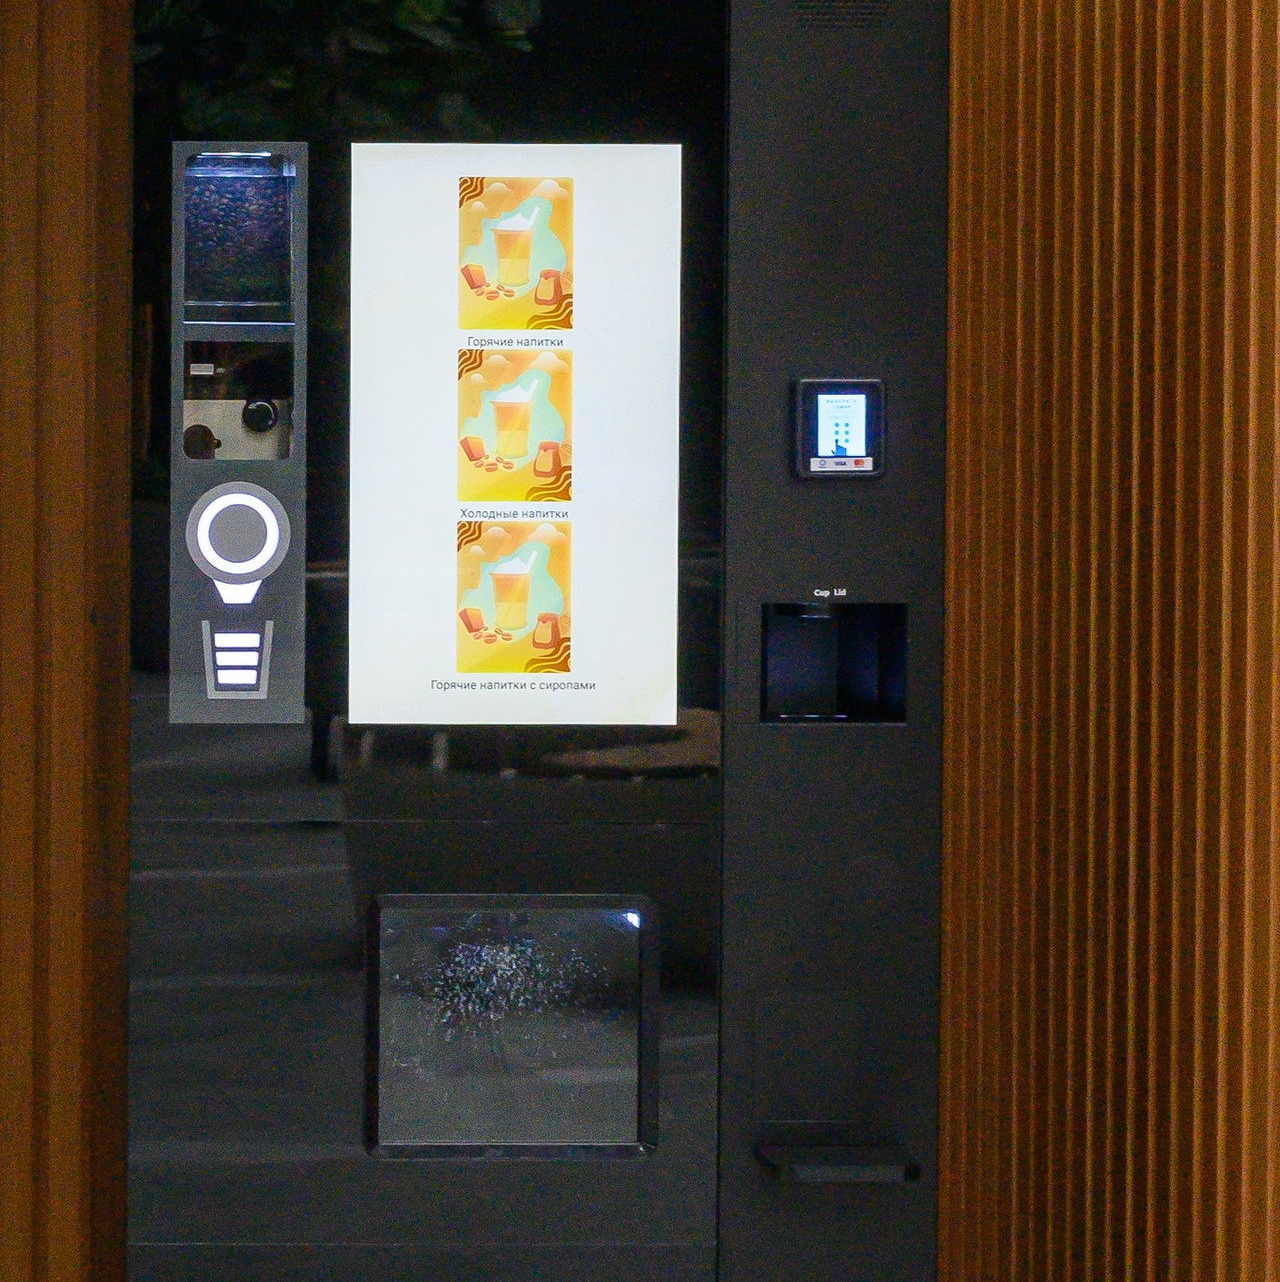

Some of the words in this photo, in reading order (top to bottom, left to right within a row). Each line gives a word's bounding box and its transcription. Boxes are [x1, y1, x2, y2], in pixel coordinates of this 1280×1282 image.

[467, 336, 514, 348] Горячие
[516, 338, 564, 347] напитки
[460, 508, 519, 519] Холодные
[521, 510, 569, 519] напитки
[813, 588, 830, 598] Cup
[833, 588, 847, 596] Lid
[430, 679, 477, 691] Горячие
[479, 681, 527, 690] напитки
[529, 682, 536, 690] с
[538, 682, 596, 692] сиропами
